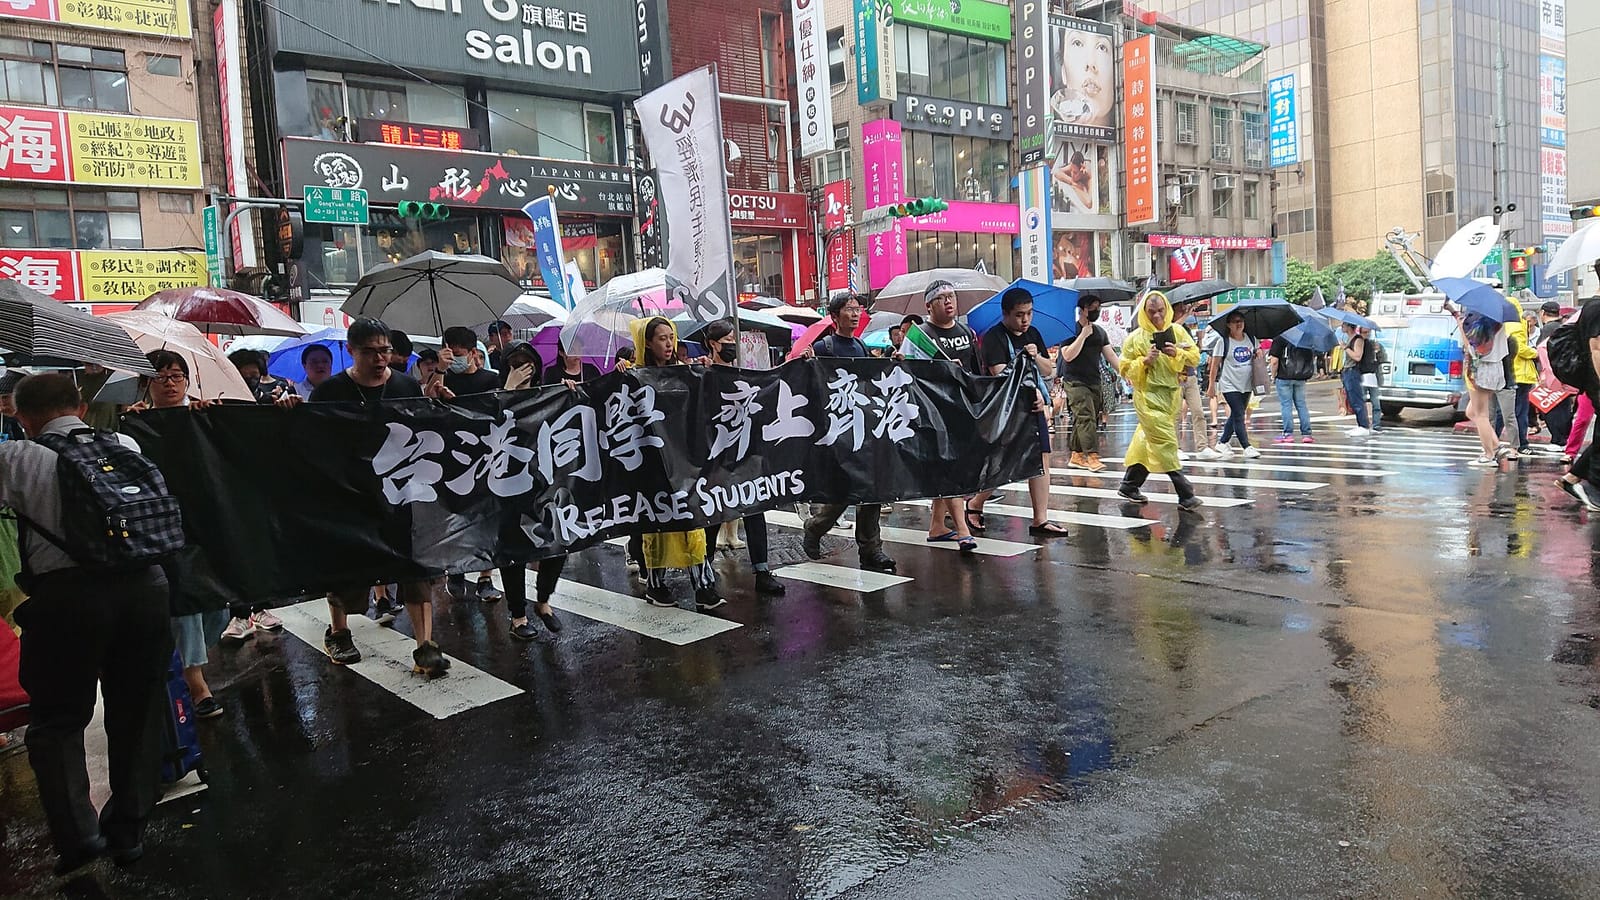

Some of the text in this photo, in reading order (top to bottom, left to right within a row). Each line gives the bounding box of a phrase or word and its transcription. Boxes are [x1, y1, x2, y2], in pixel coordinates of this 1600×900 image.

[521, 3, 587, 33] 旗艦店
[637, 0, 648, 43] on
[465, 27, 592, 74] salon
[799, 17, 816, 83] 優仕紳
[1023, 3, 1036, 128] People
[906, 96, 1003, 127] People
[0, 115, 58, 174] 海
[382, 124, 461, 149] 請上三樓
[531, 166, 581, 178] JAPAN
[1025, 152, 1041, 162] 3F
[312, 189, 361, 202] 公園路
[872, 162, 884, 257] 十三川日定食
[1029, 234, 1039, 277] 中華電信
[948, 335, 970, 348] YOU
[1407, 349, 1446, 360] AAB-665
[1540, 391, 1566, 408] CHIN
[372, 365, 920, 505] 台港同學 齊上齊落
[557, 469, 804, 541] RELEASE STUDENTS
